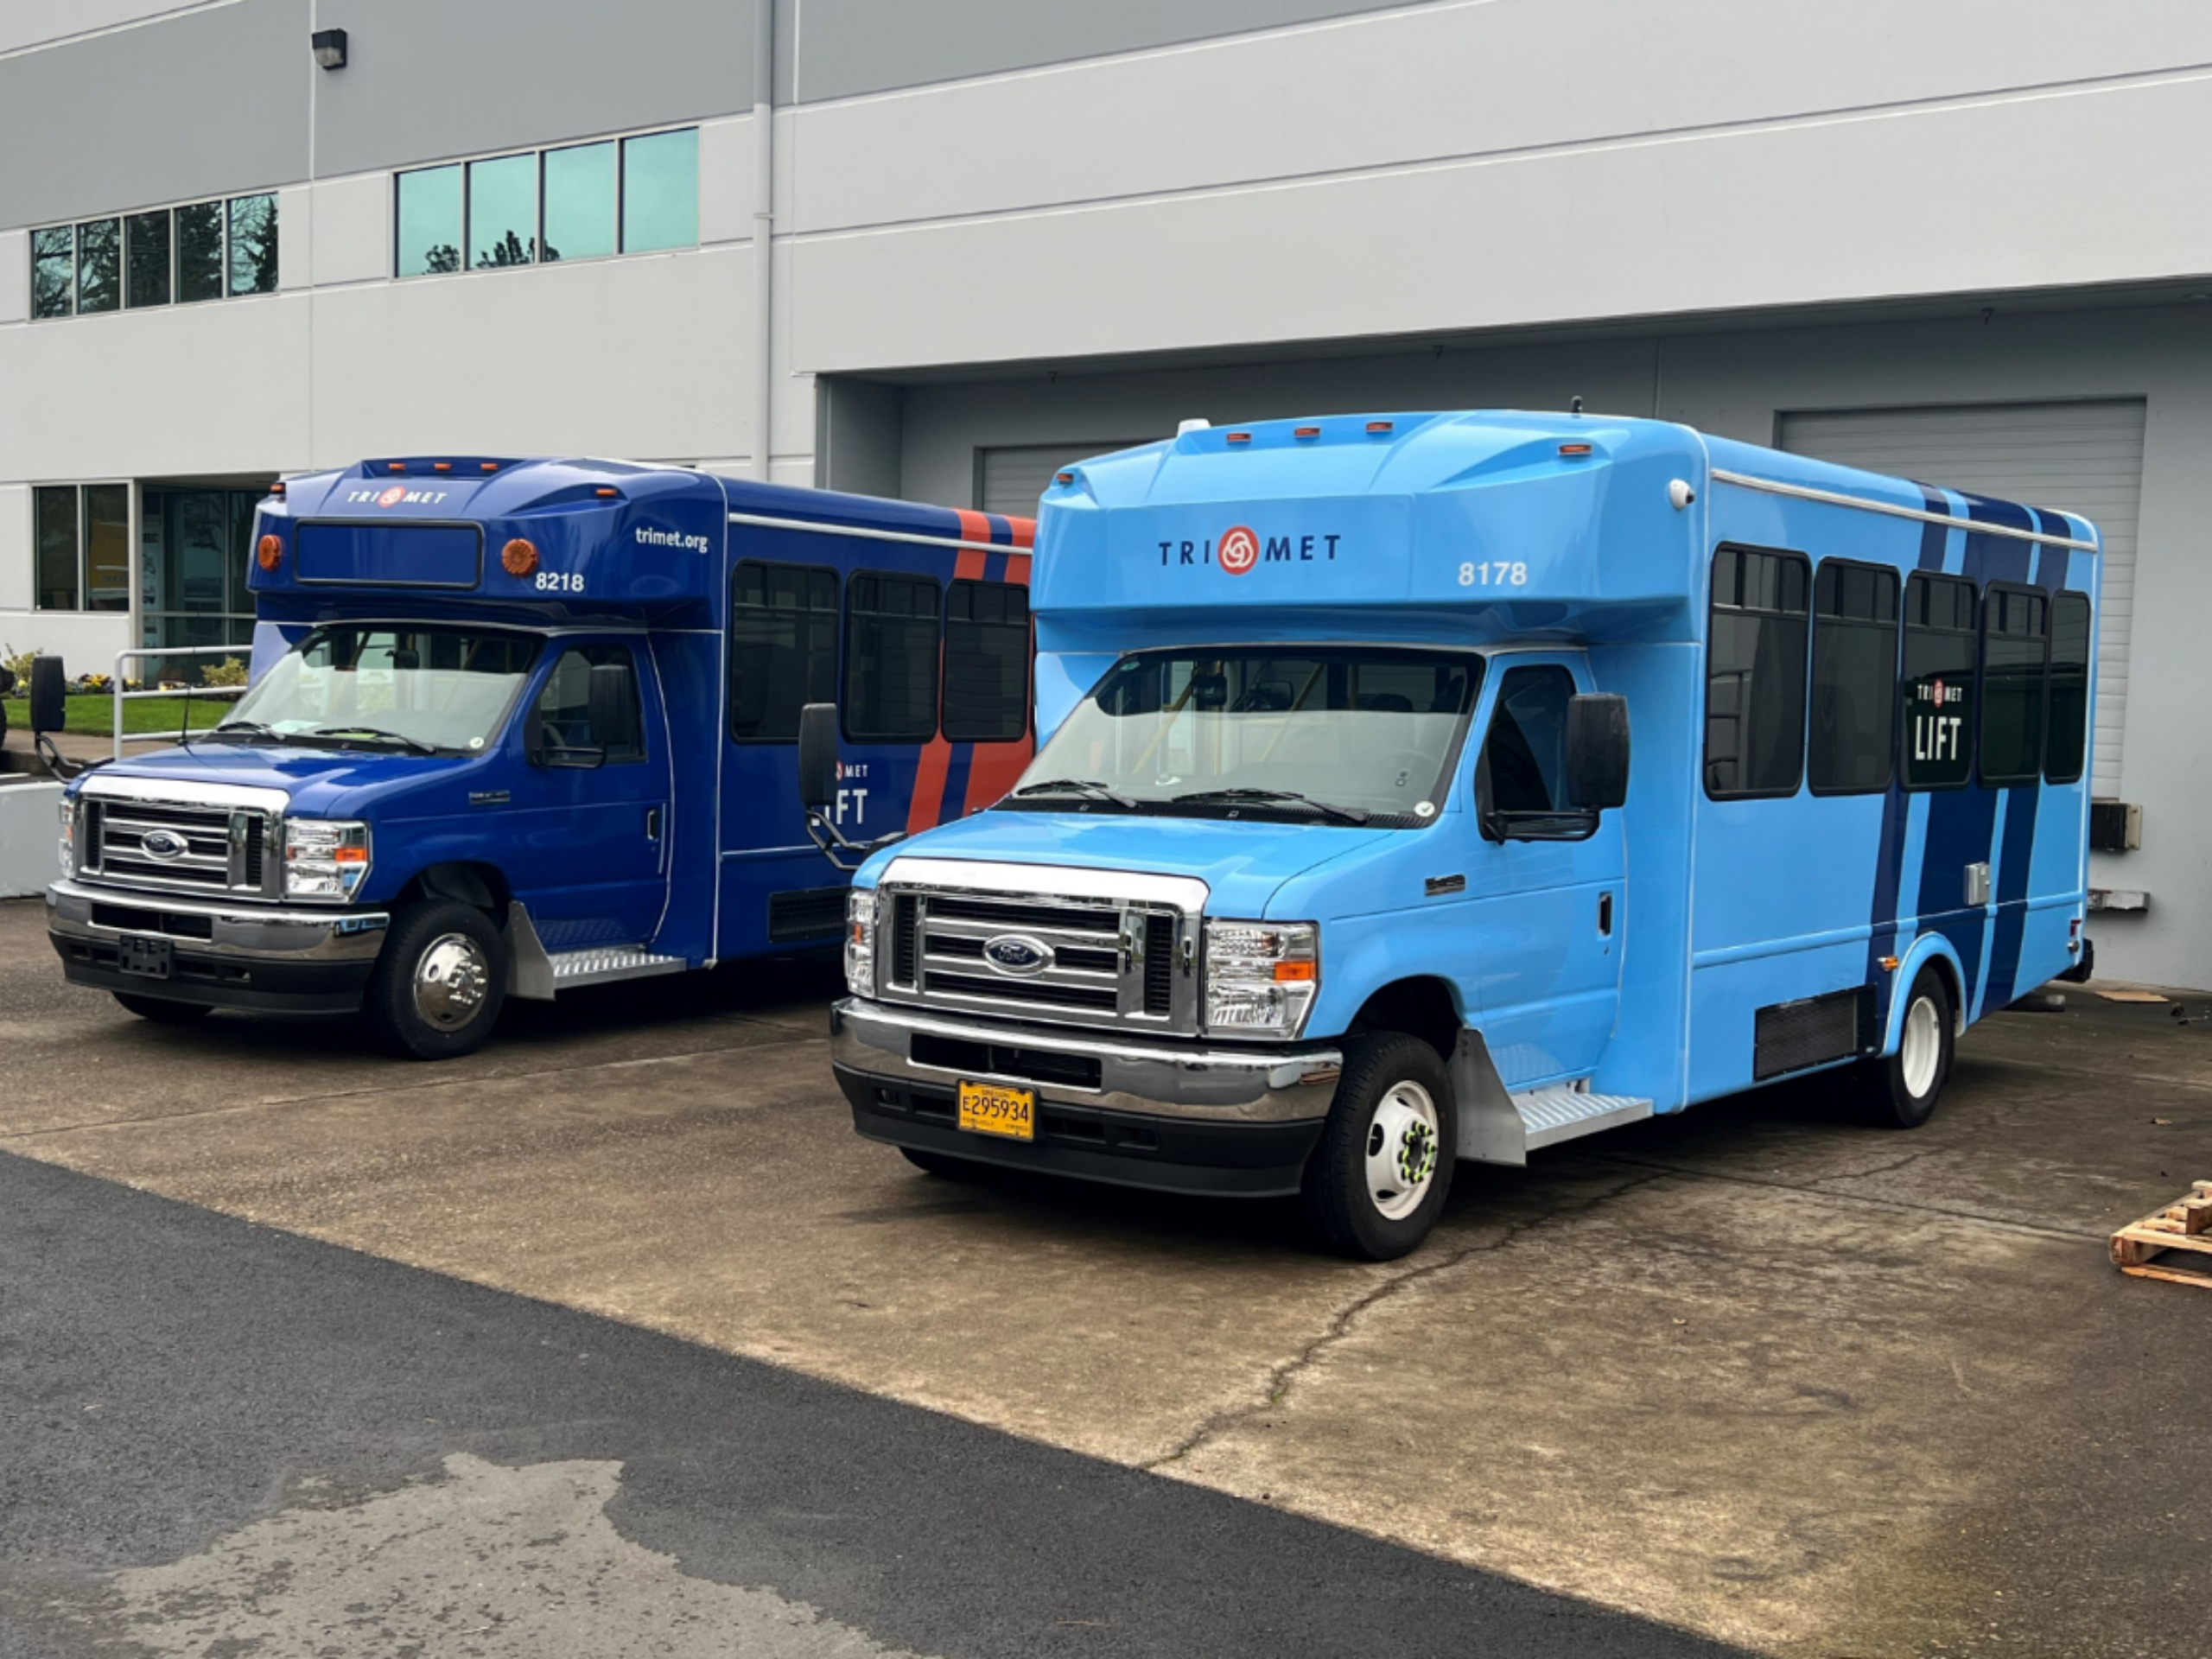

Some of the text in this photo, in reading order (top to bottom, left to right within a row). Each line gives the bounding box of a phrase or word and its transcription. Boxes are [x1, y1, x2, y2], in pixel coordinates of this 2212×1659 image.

[635, 527, 709, 554] trimet.org
[1159, 535, 1341, 566] TRI MET
[535, 572, 584, 592] 8218
[1458, 562, 1527, 586] 8178
[1915, 715, 1961, 760] LIFT
[844, 765, 868, 777] MET
[963, 1095, 1029, 1122] E295934
